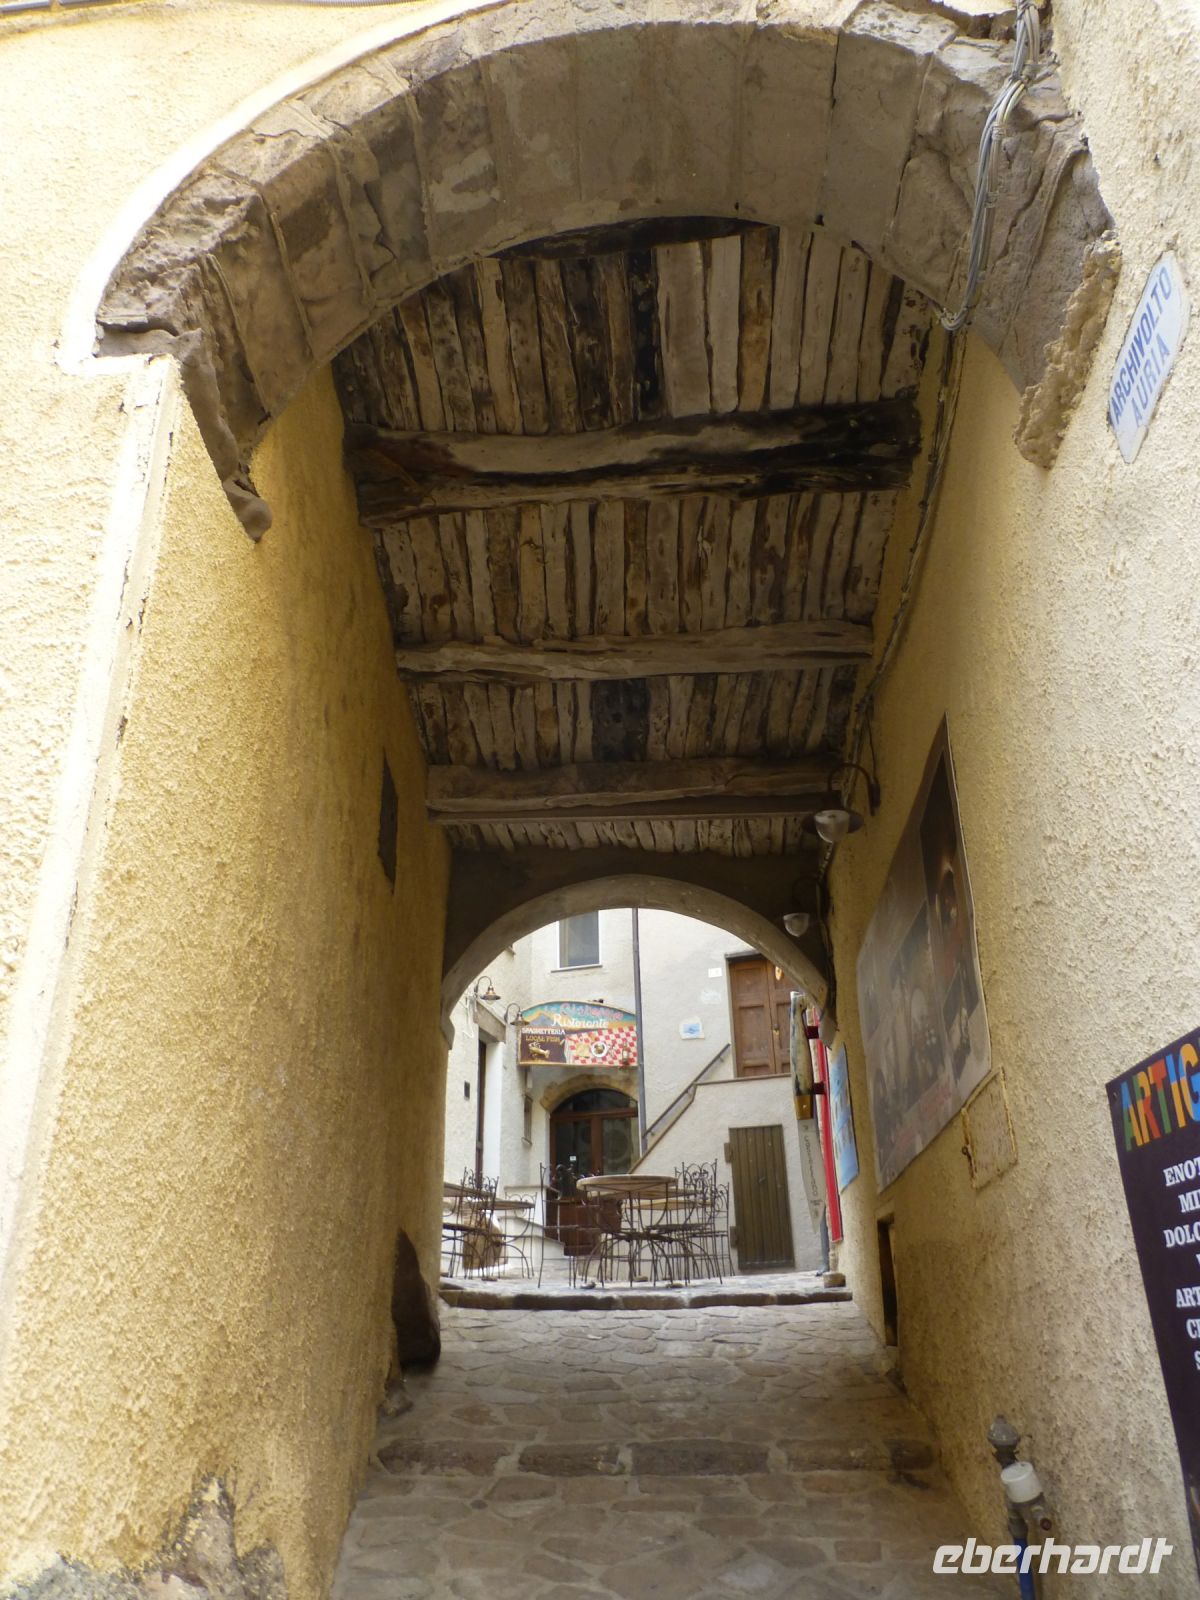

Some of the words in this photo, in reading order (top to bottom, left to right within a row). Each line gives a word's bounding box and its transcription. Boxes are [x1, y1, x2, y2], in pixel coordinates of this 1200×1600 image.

[1110, 266, 1173, 425] ARCHIVOLTO
[1131, 333, 1171, 428] AURIA
[521, 1027, 566, 1035] SPAGHETTERIA
[1121, 1042, 1200, 1151] ARTIG
